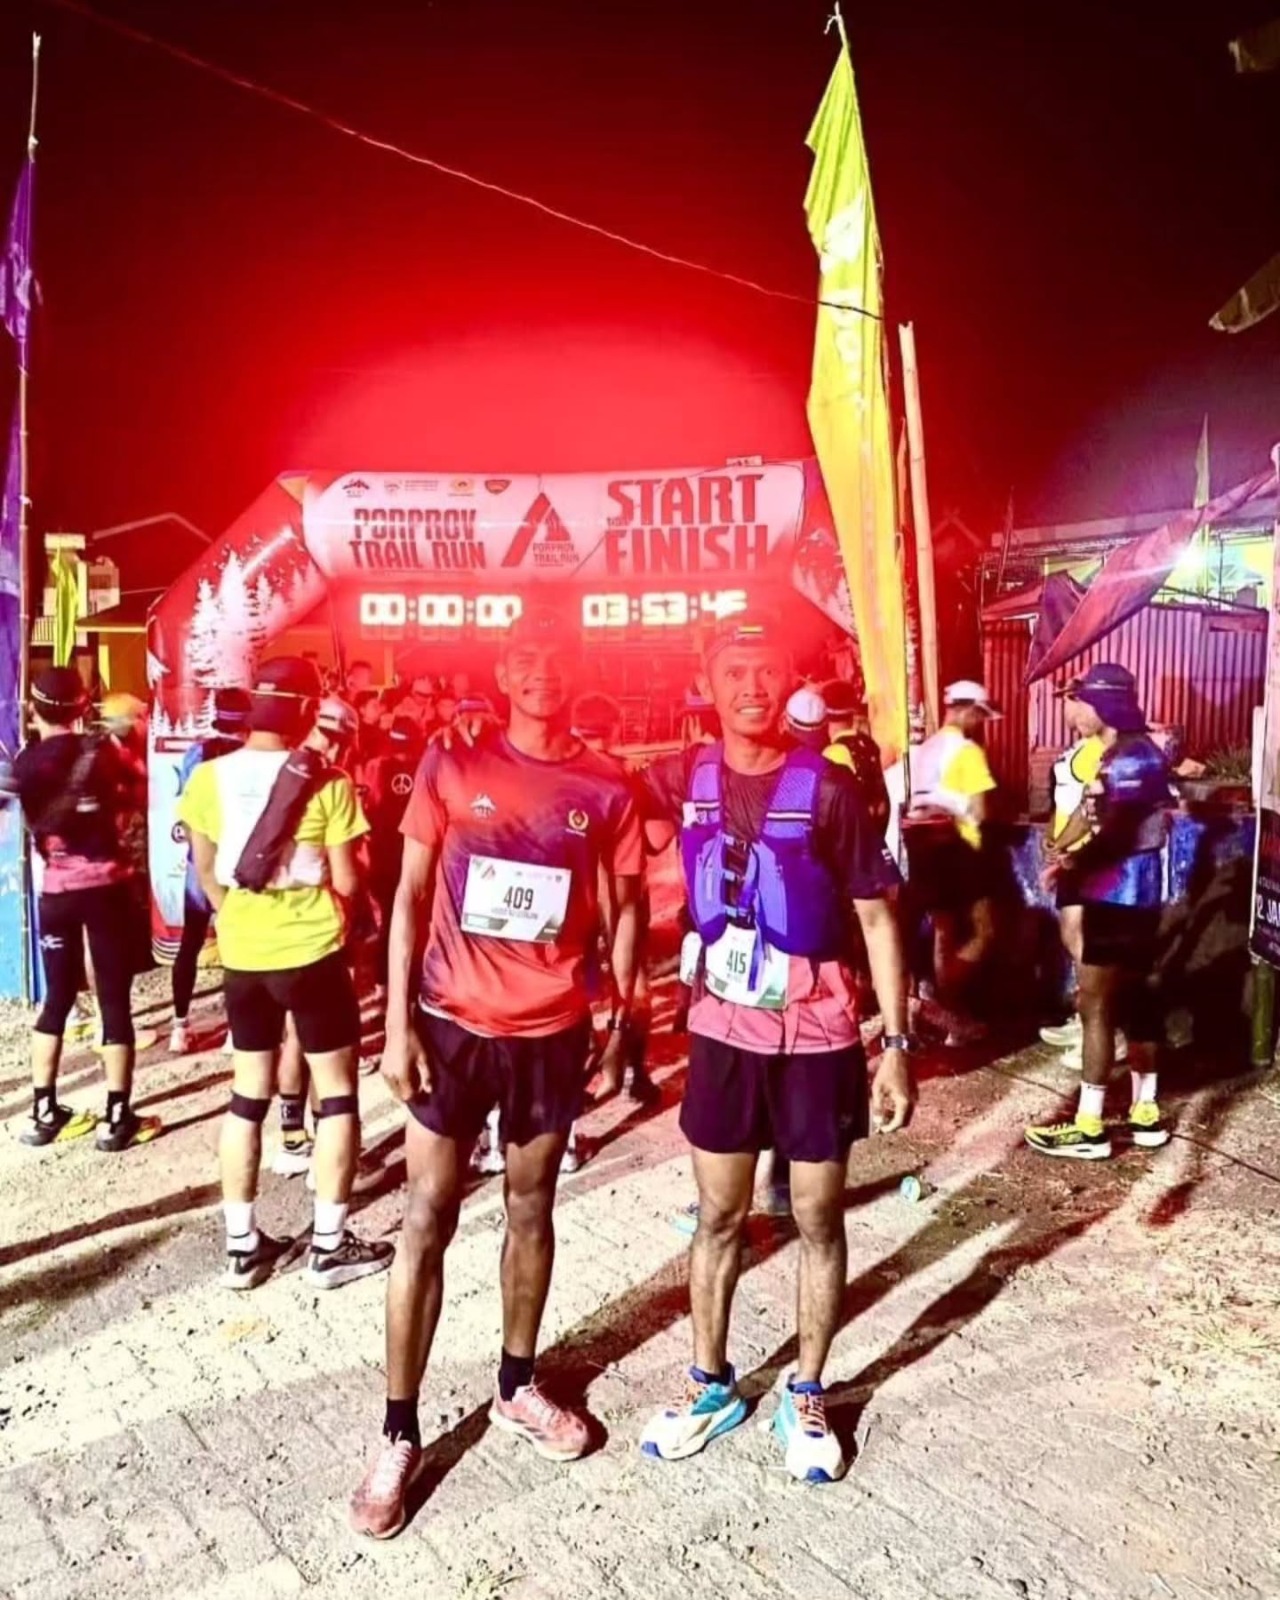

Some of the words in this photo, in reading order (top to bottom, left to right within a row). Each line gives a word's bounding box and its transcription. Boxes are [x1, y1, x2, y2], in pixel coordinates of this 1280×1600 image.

[607, 474, 764, 526] START
[354, 508, 477, 540] PORPROV
[349, 540, 424, 569] TRAIL
[431, 541, 487, 569] RUN
[534, 553, 559, 563] TRAIL
[605, 525, 768, 576] FINISH
[503, 885, 534, 910] 409
[726, 949, 747, 974] 415
